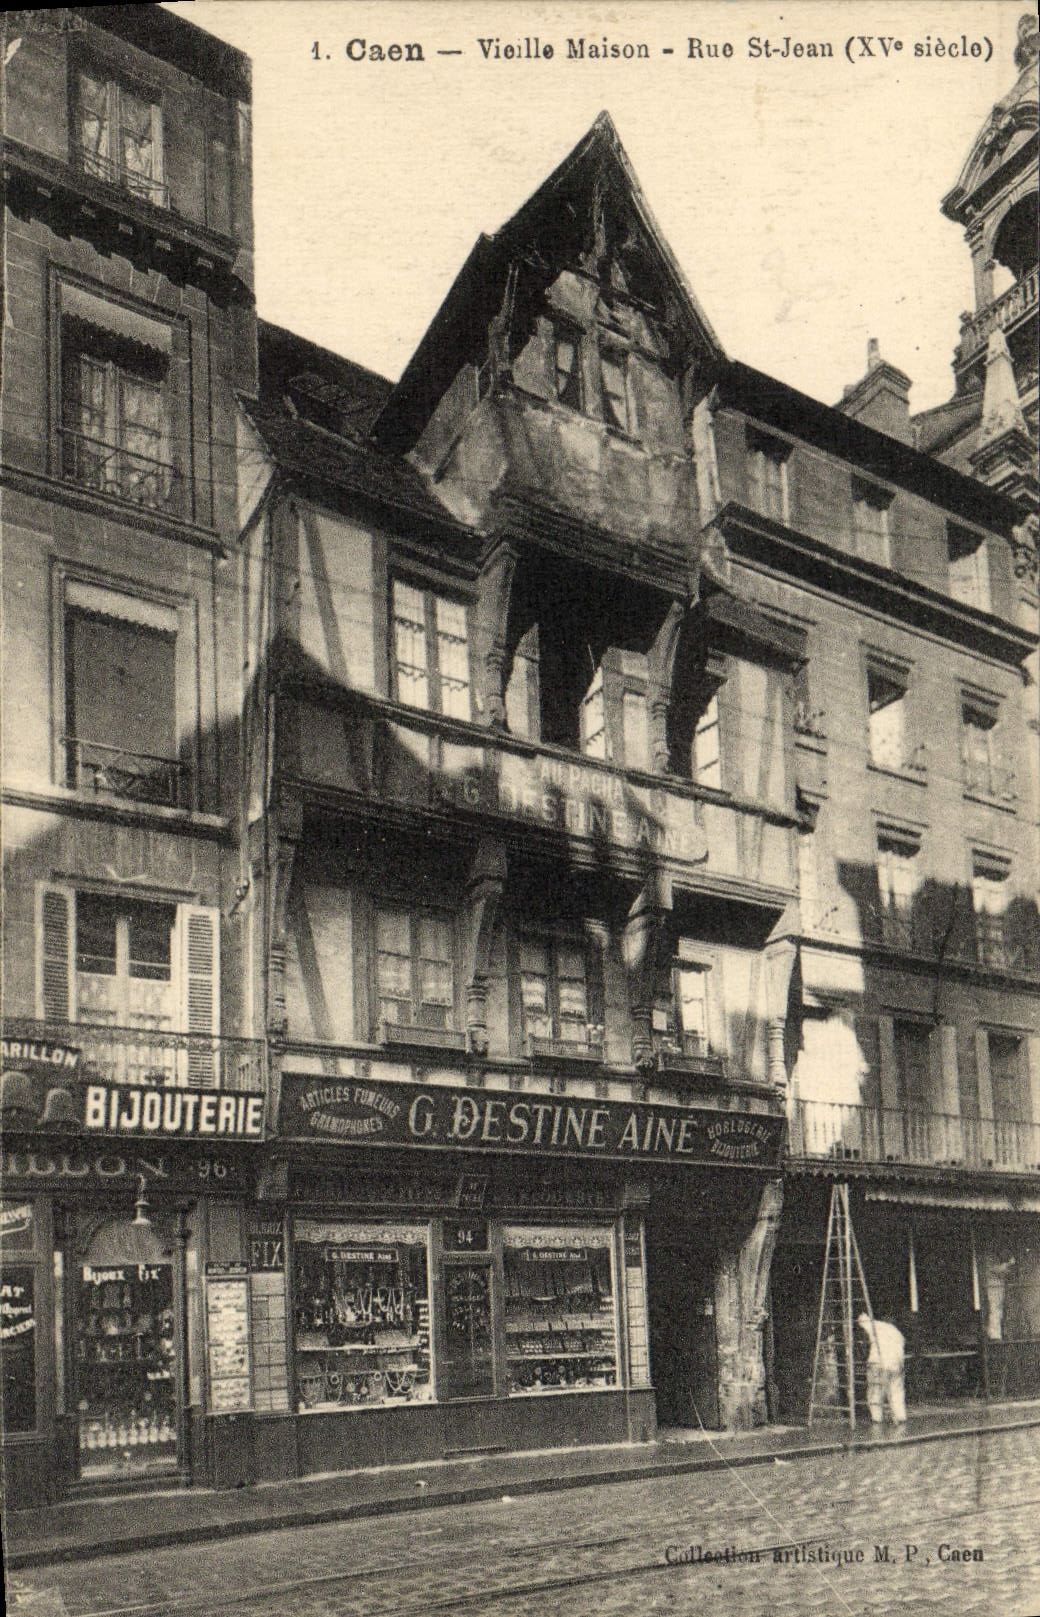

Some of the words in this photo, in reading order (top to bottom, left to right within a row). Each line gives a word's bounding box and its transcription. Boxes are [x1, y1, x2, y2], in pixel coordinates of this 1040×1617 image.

[85, 1085, 264, 1134] BIJOUTERIE
[299, 1086, 350, 1112] ARTICLES
[354, 1087, 401, 1120] FUMEURS
[408, 1095, 437, 1137] G.
